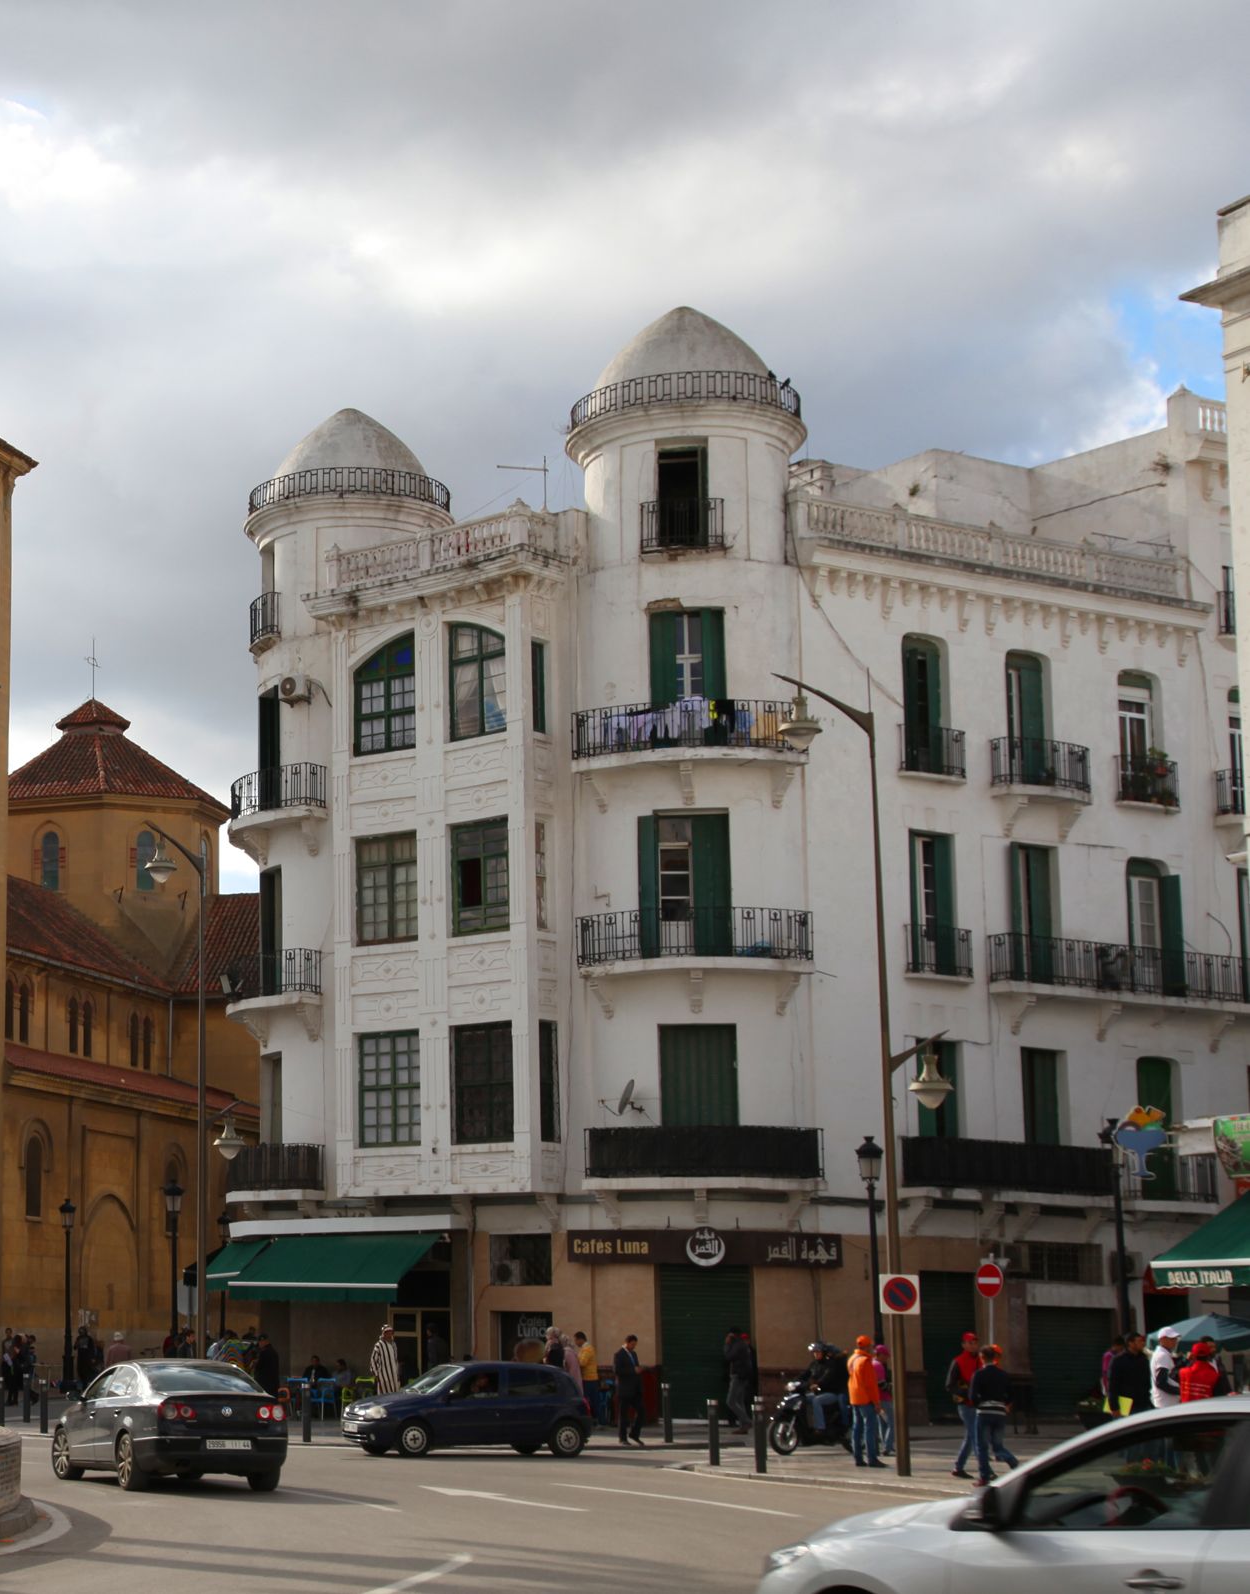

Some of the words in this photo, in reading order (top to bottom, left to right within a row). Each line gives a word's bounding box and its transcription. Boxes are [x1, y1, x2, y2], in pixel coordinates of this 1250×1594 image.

[616, 1239, 650, 1254] Luna
[766, 1237, 797, 1262] القمر
[801, 1238, 837, 1264] قهوة
[1168, 1270, 1199, 1284] BELLA
[1199, 1269, 1234, 1284] ITALIA
